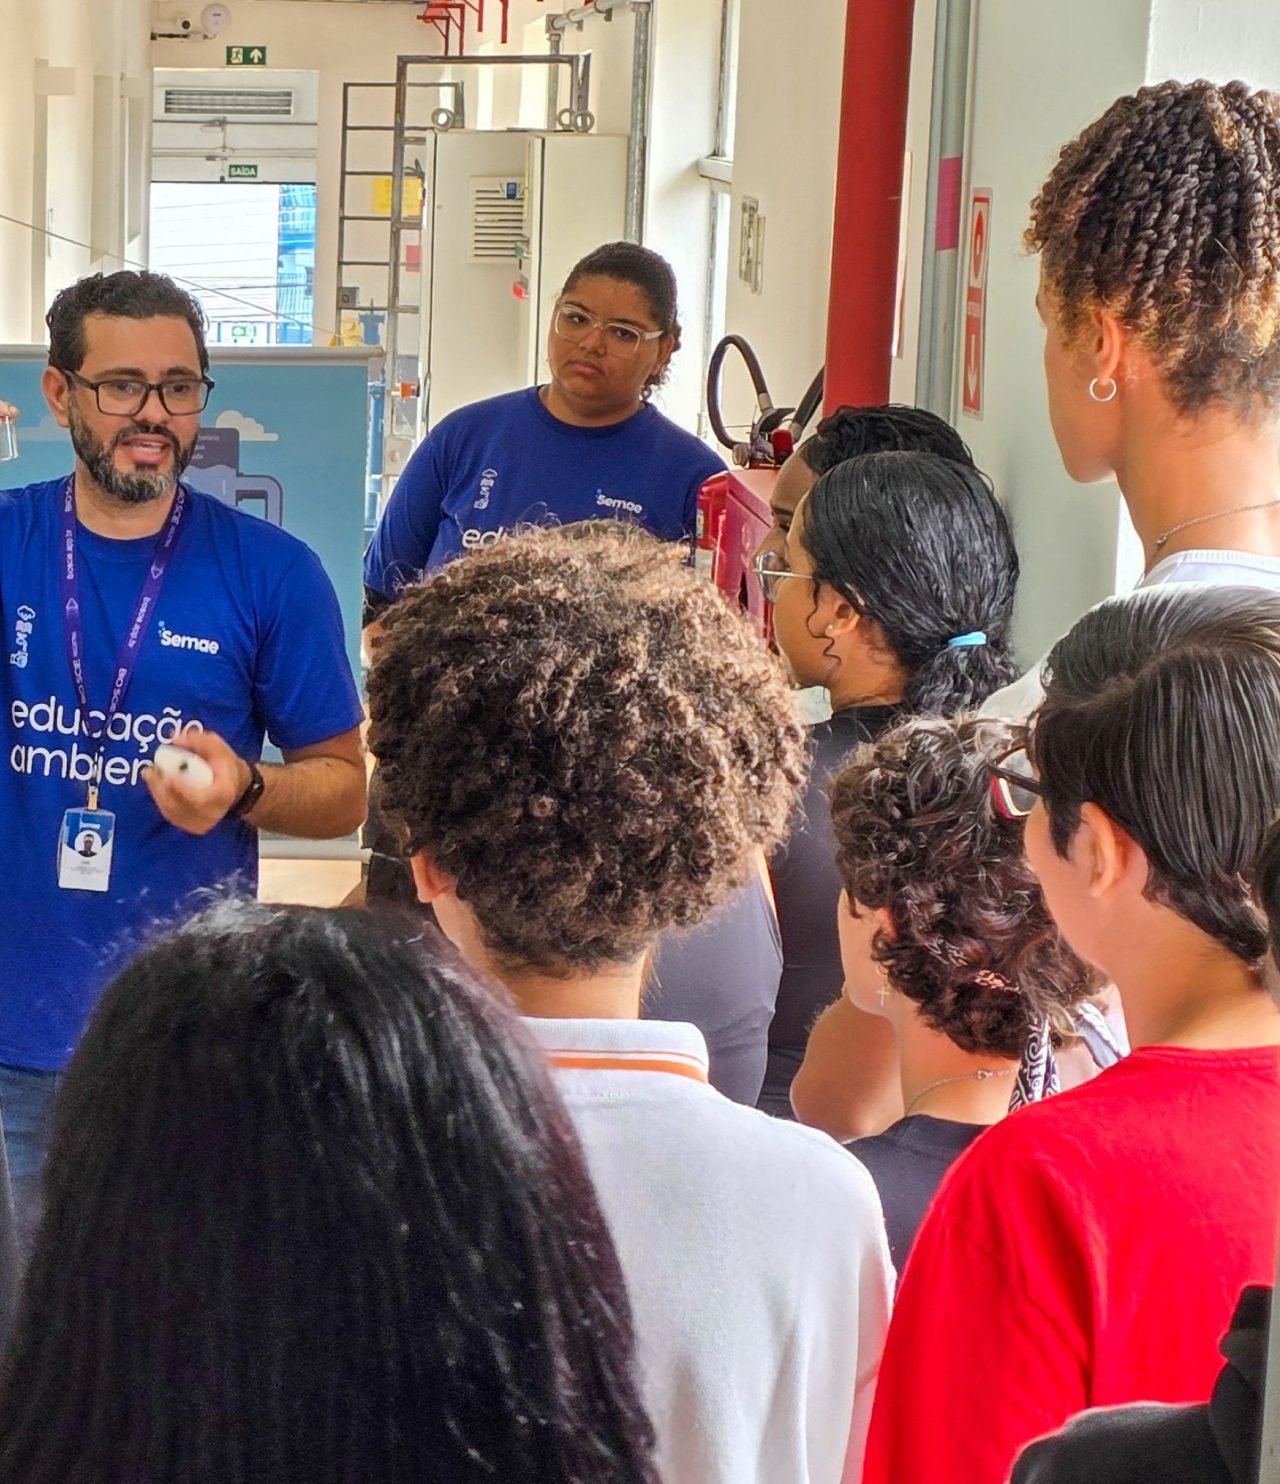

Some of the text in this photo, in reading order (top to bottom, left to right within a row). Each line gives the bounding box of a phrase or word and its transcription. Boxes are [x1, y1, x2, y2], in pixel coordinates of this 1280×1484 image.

[230, 166, 256, 176] SAÍDA
[597, 494, 643, 514] Semae
[161, 630, 220, 655] Semae
